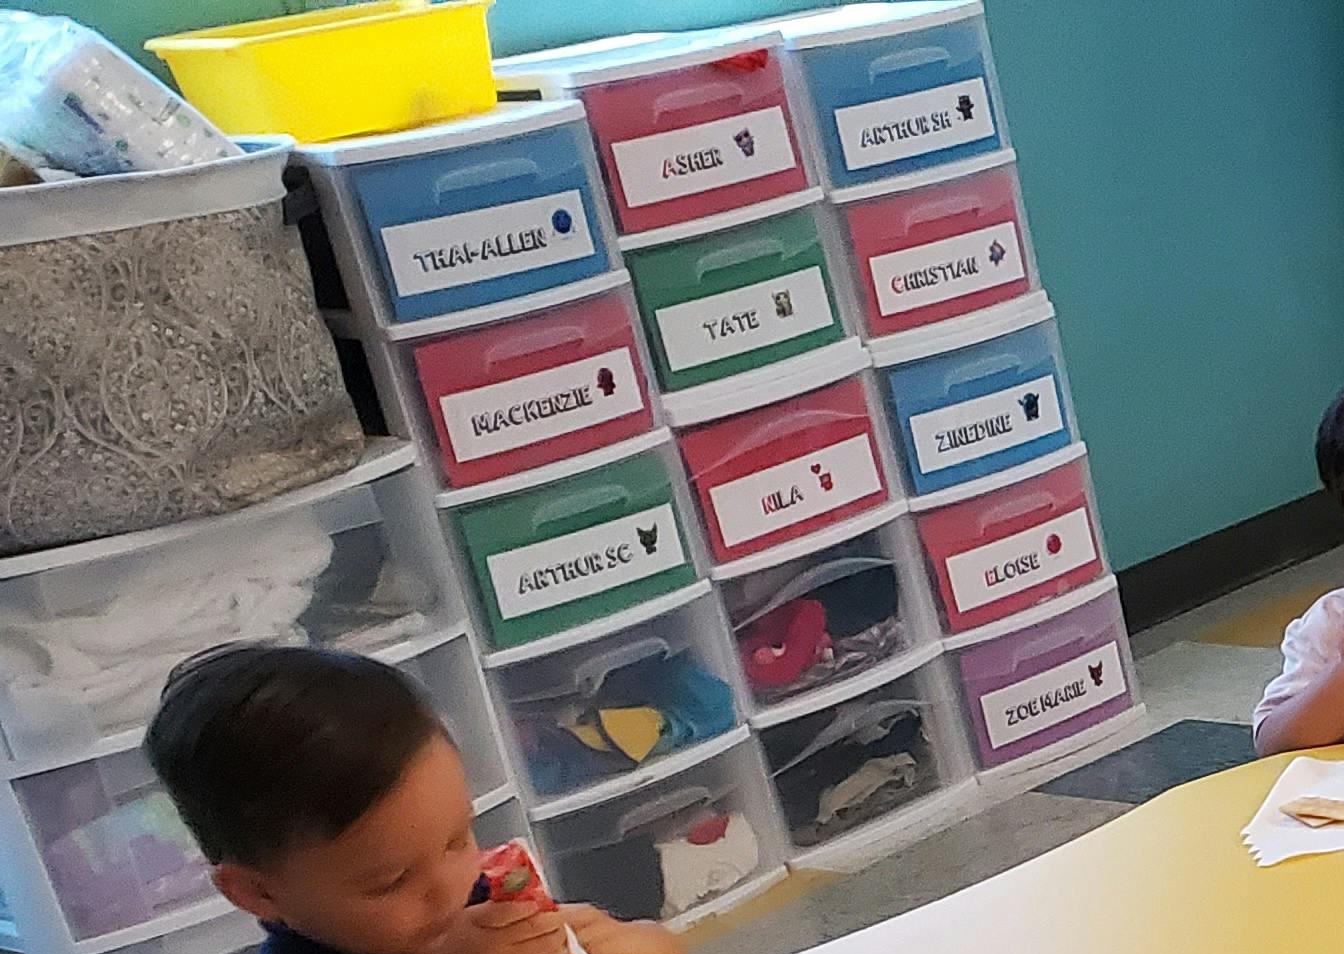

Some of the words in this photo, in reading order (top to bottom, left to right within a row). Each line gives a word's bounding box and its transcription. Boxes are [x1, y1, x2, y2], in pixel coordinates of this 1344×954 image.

[661, 148, 724, 180] ASHER
[412, 228, 548, 274] THAI-ALLEN
[890, 259, 980, 296] CHRISTIAN
[702, 309, 761, 341] TATE
[471, 386, 594, 437] MACKENZIE
[934, 413, 1013, 454] ZINEDINE
[984, 553, 1040, 588] ELOISE
